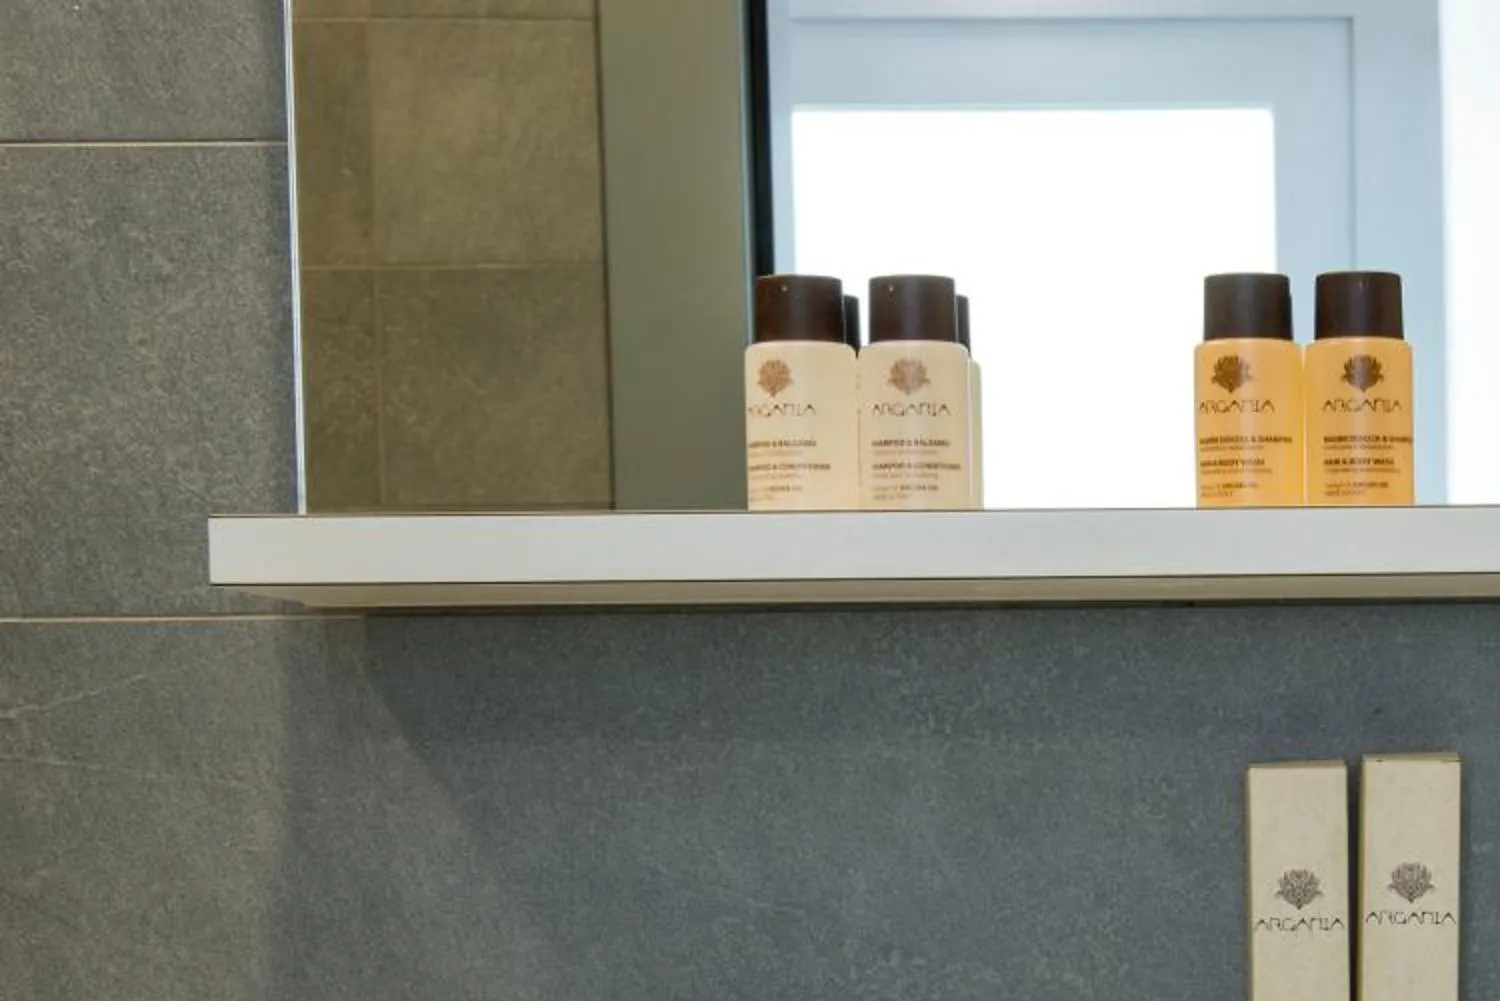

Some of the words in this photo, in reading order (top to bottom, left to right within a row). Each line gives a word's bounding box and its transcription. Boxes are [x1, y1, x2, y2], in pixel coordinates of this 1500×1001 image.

[872, 402, 951, 417] ARGANIA
[1322, 398, 1402, 413] ARGANIA
[1253, 916, 1345, 932] ARGANIA
[1365, 909, 1457, 926] ARGANIA
